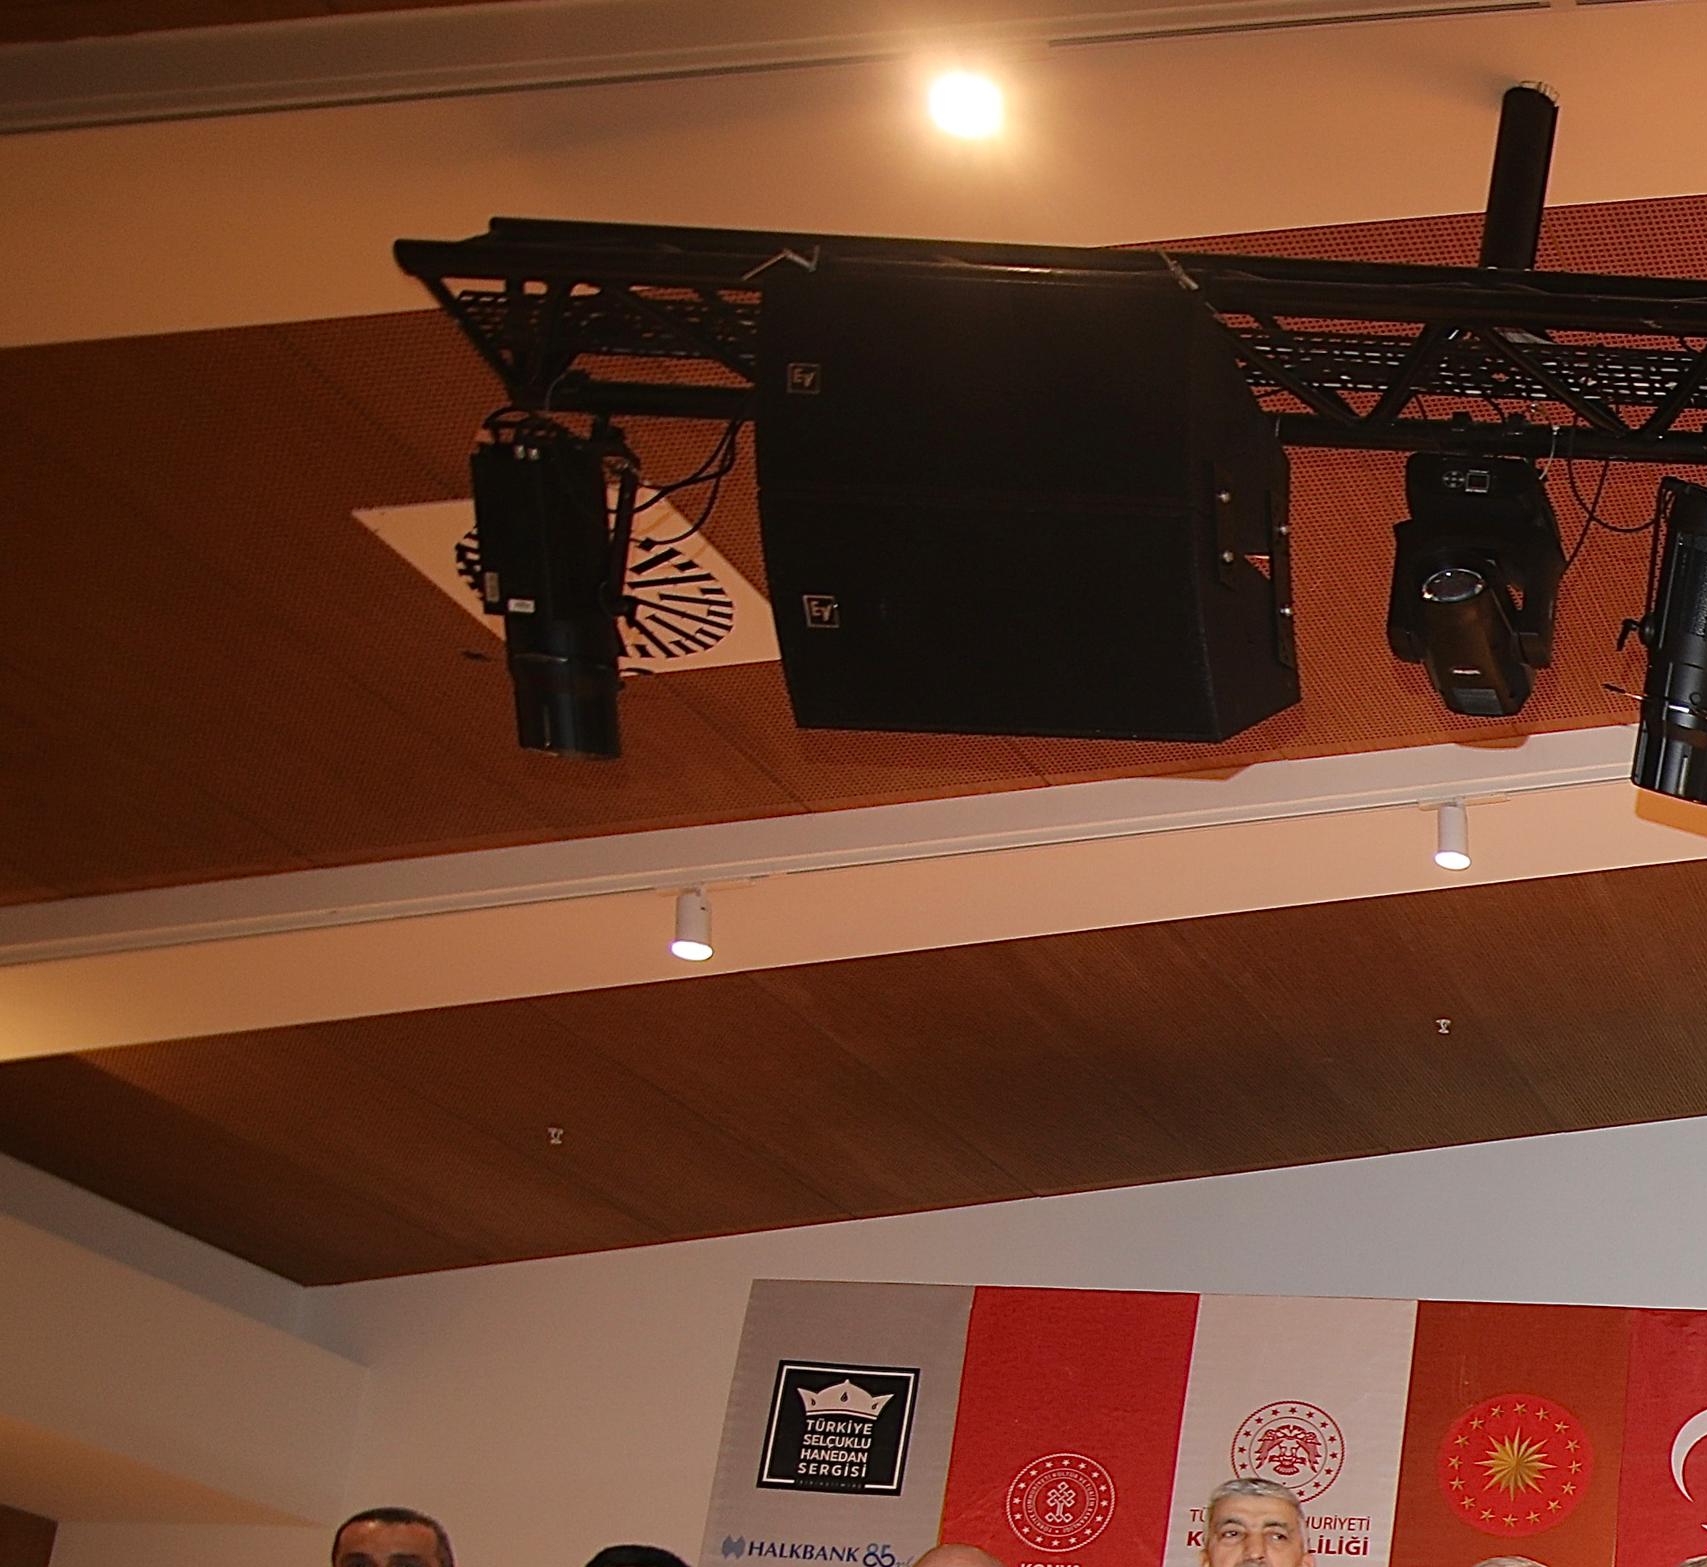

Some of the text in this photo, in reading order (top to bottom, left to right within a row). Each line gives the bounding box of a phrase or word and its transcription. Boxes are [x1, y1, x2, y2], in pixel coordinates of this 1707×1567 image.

[806, 1418, 873, 1435] TÜRKİYE
[803, 1434, 871, 1448] SELÇUKLU
[800, 1448, 868, 1463] HANEDAN
[797, 1462, 867, 1477] SERGİSİ
[748, 1541, 859, 1562] HALKBANK
[862, 1543, 896, 1567] 85
